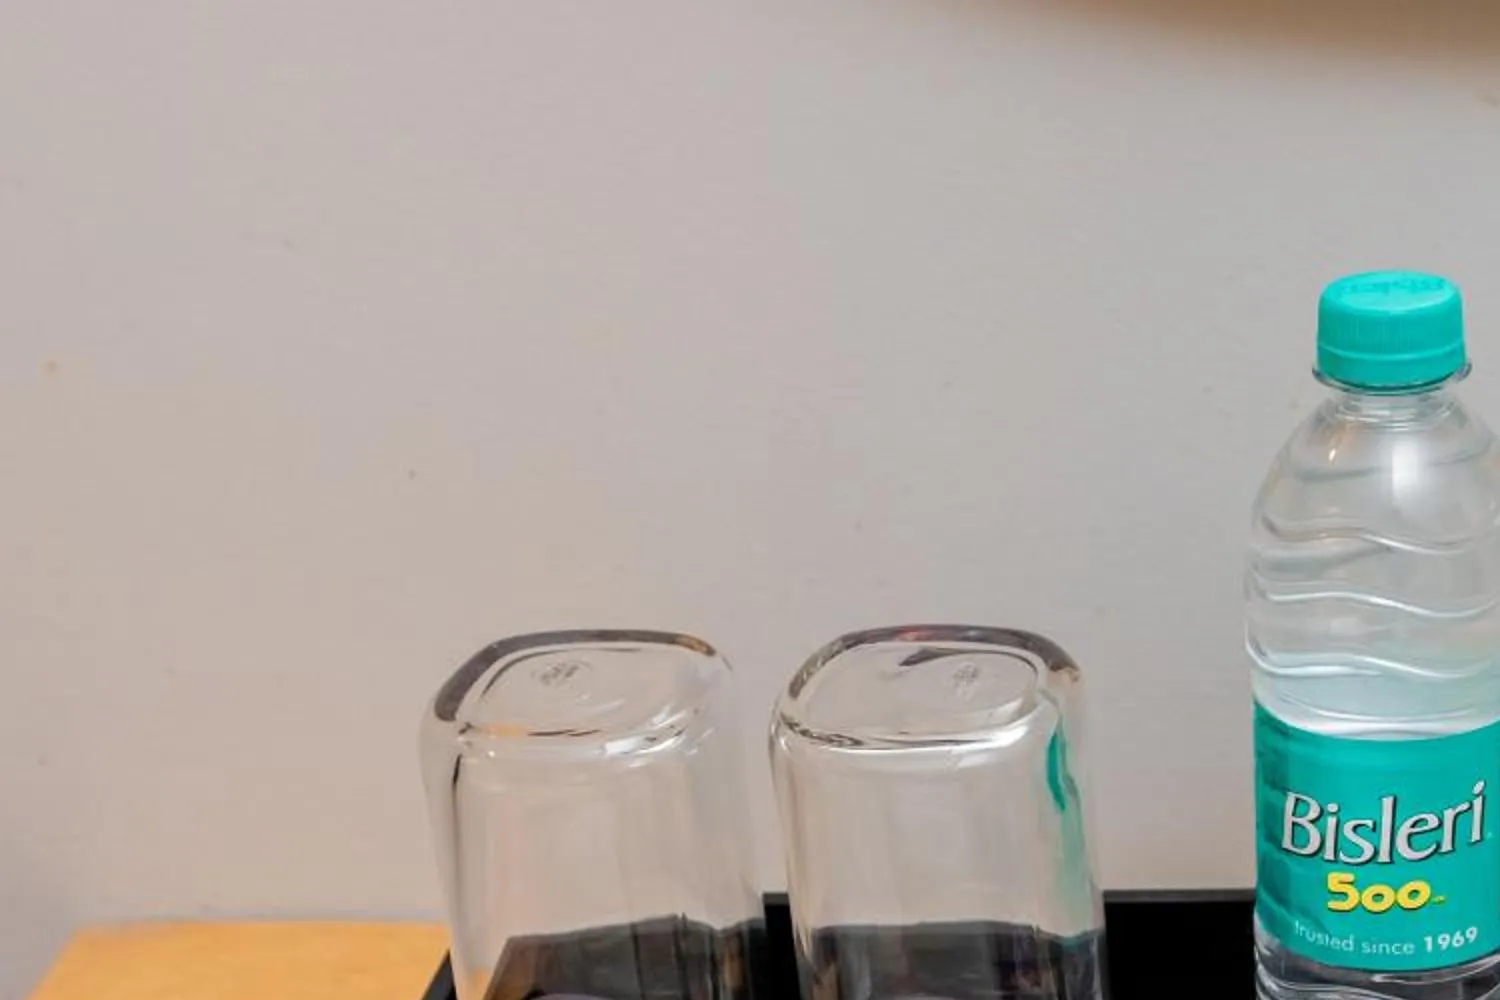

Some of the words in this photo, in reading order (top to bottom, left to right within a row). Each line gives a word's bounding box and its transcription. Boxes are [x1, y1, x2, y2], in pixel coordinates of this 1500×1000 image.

[1281, 780, 1488, 866] Bisleri
[1326, 871, 1432, 913] 500
[1295, 919, 1355, 951] trusted
[1361, 939, 1416, 955] since
[1423, 926, 1479, 952] 1969
